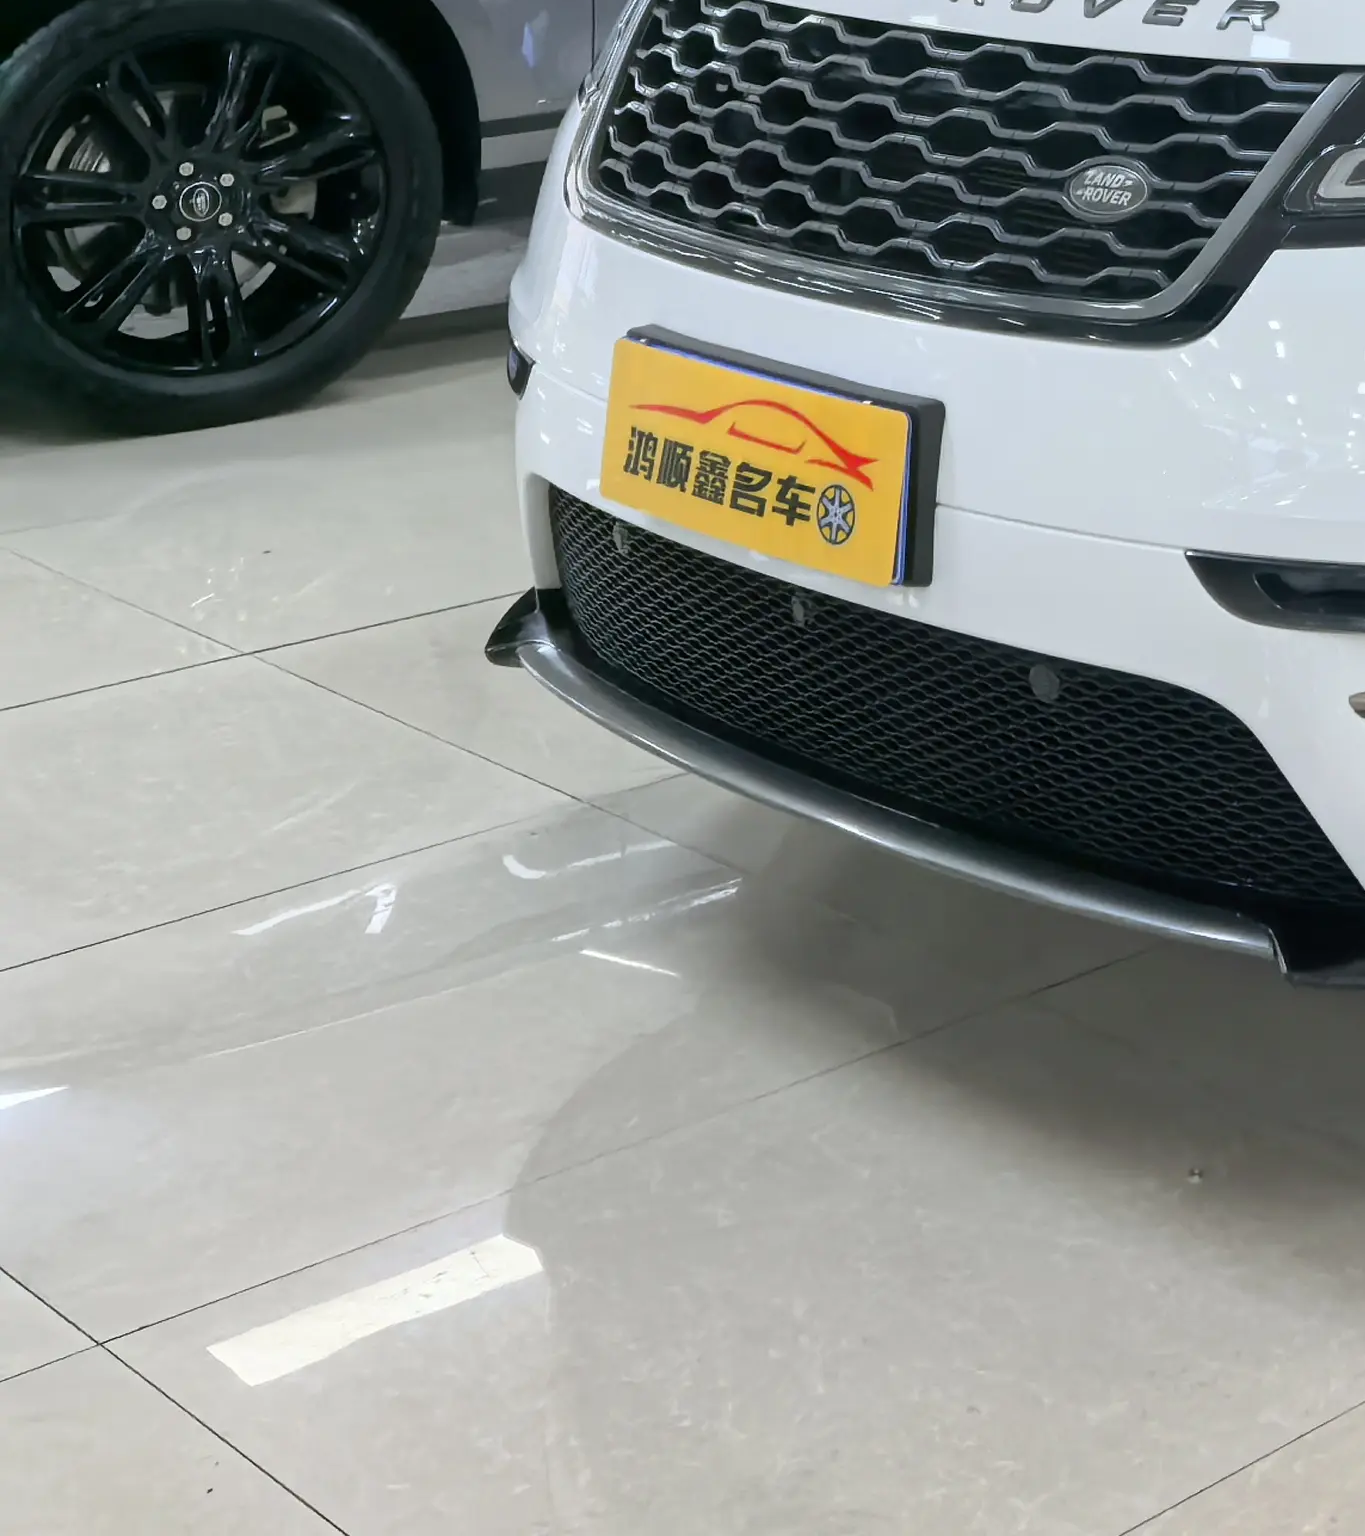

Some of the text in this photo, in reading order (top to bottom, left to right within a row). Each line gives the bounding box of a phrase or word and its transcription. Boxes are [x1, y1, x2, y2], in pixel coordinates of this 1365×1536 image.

[1084, 168, 1126, 188] LAND
[1082, 186, 1132, 206] ROVER
[623, 425, 816, 528] 鸿顺鑫名车
